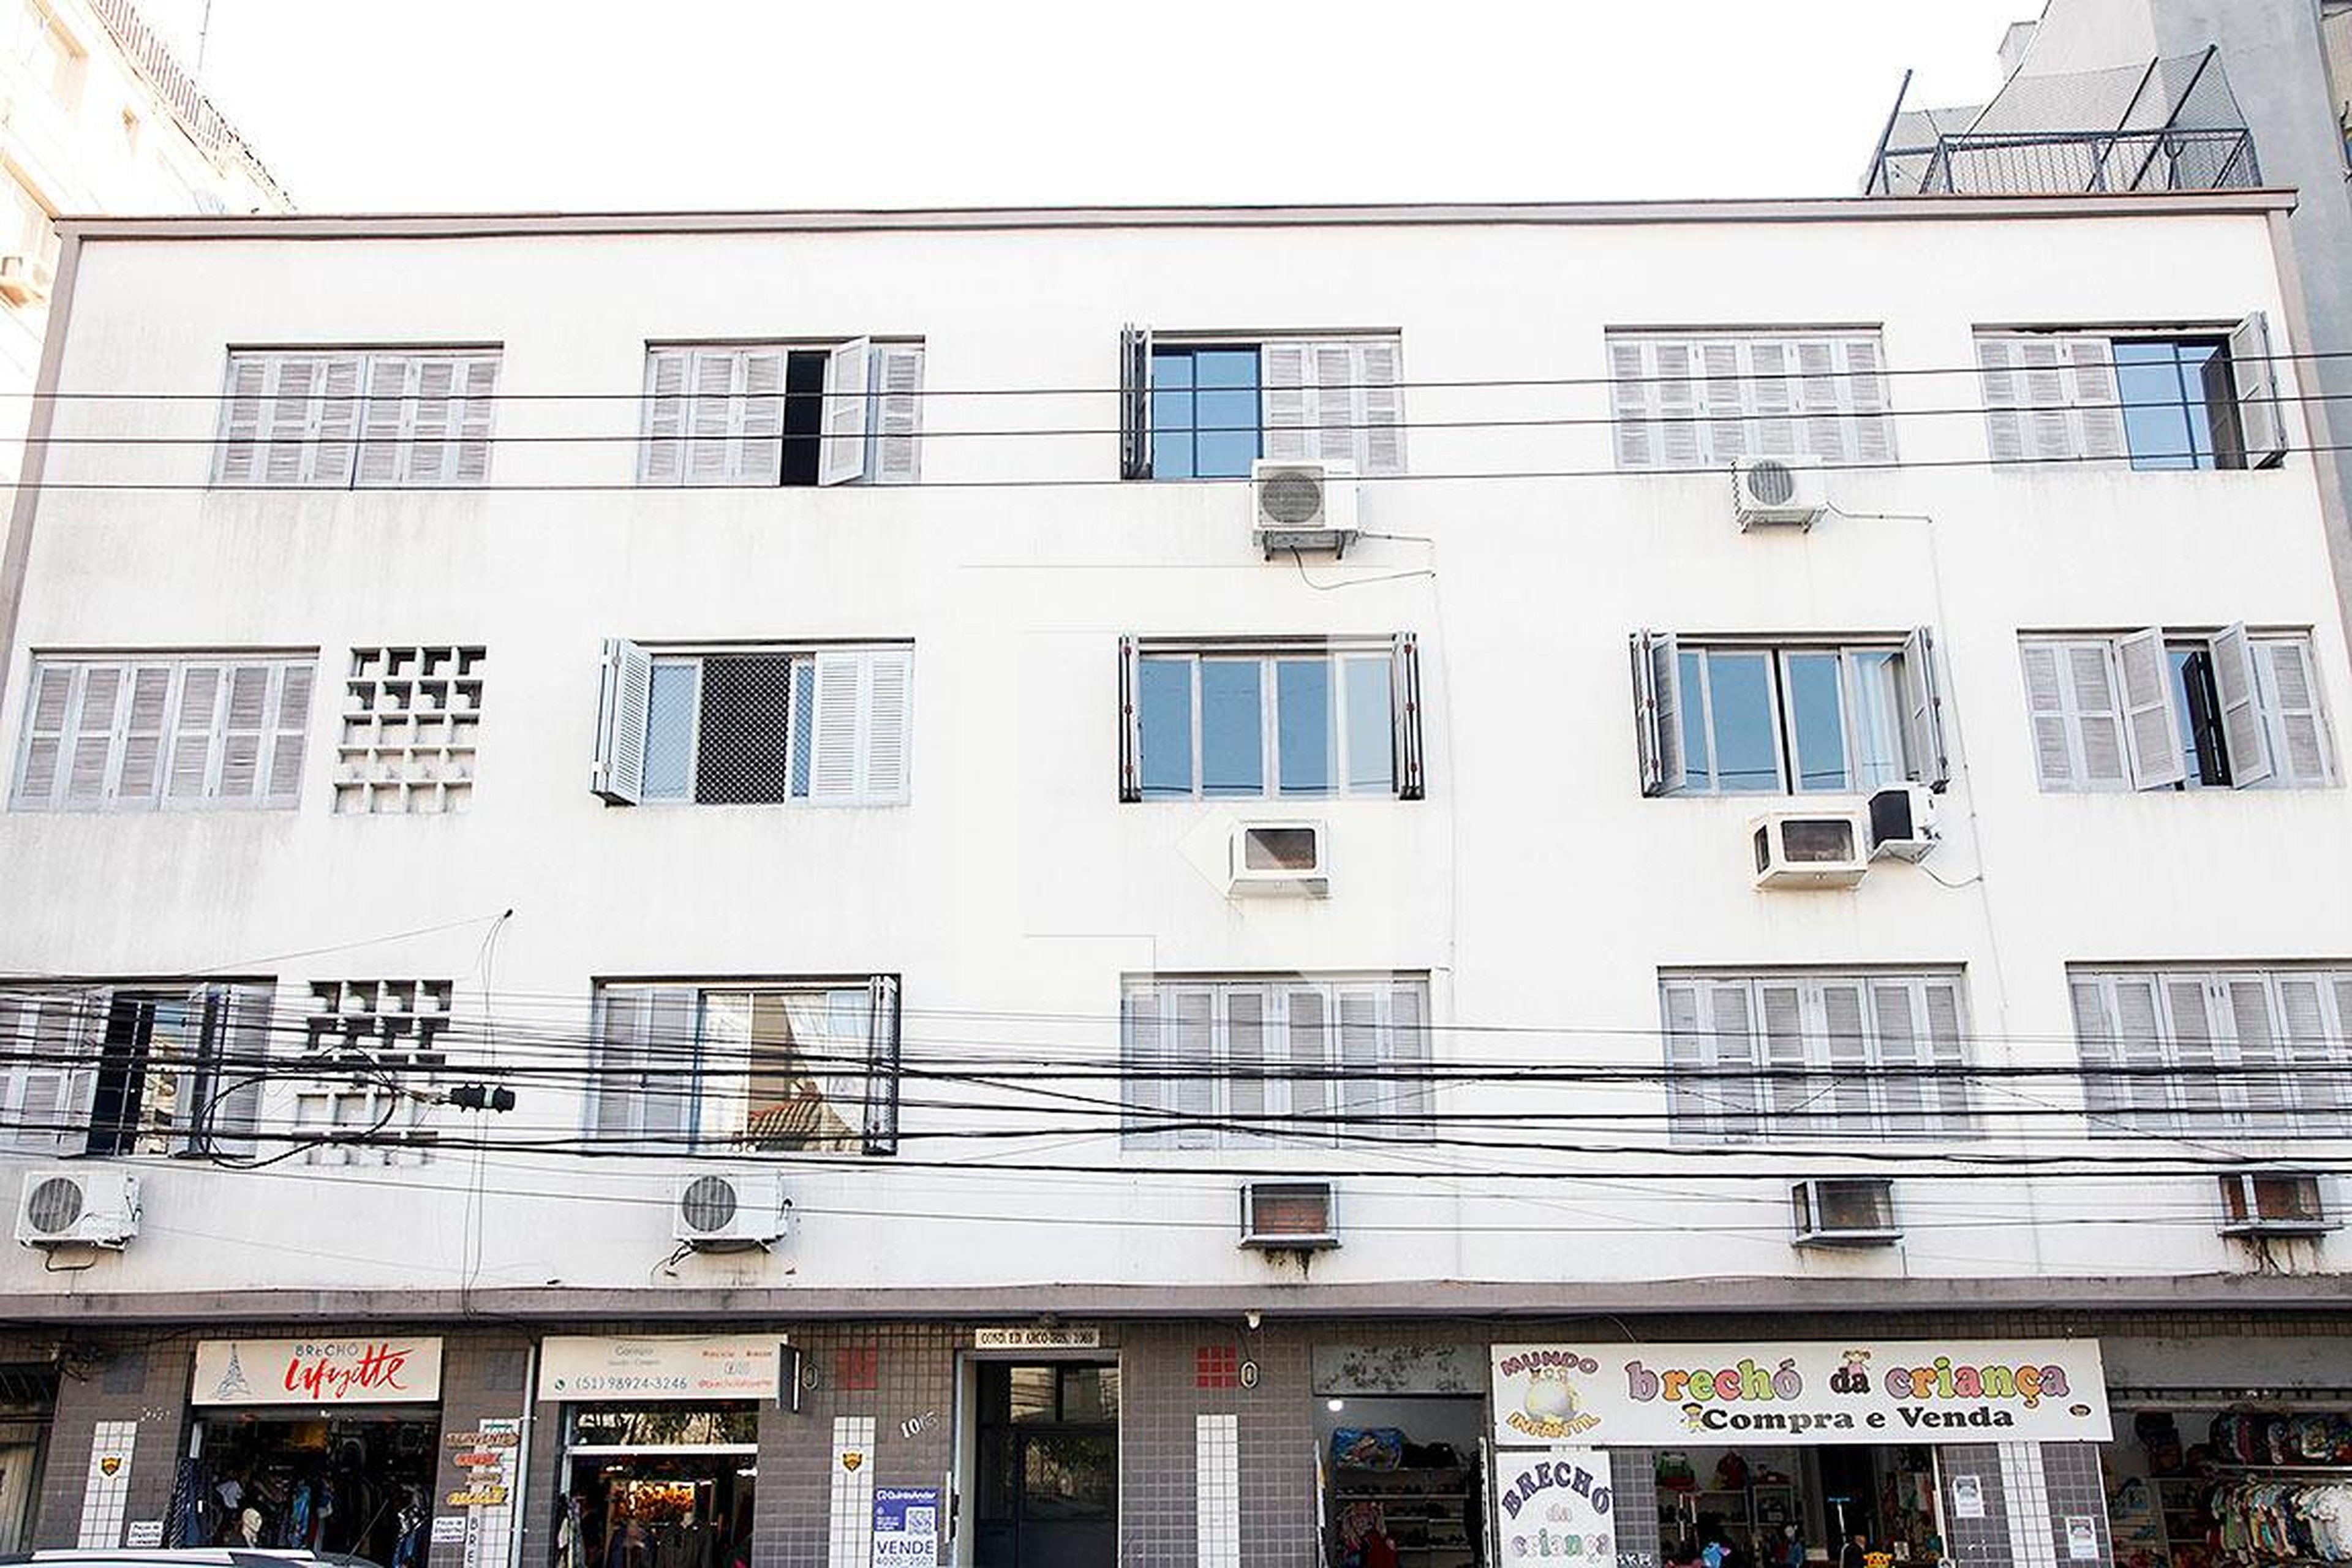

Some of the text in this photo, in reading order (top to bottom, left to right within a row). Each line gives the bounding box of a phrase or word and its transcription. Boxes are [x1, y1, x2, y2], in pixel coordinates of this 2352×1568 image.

[1500, 1351, 1599, 1377] MUNDO
[1624, 1356, 2070, 1409] brechó da criança
[1506, 1410, 1602, 1438] INFANTIL
[1701, 1406, 2014, 1434] Compra e Venda
[1501, 1461, 1613, 1520] BRECHÓ
[467, 1517, 479, 1568] BRE
[876, 1540, 934, 1555] VENDE
